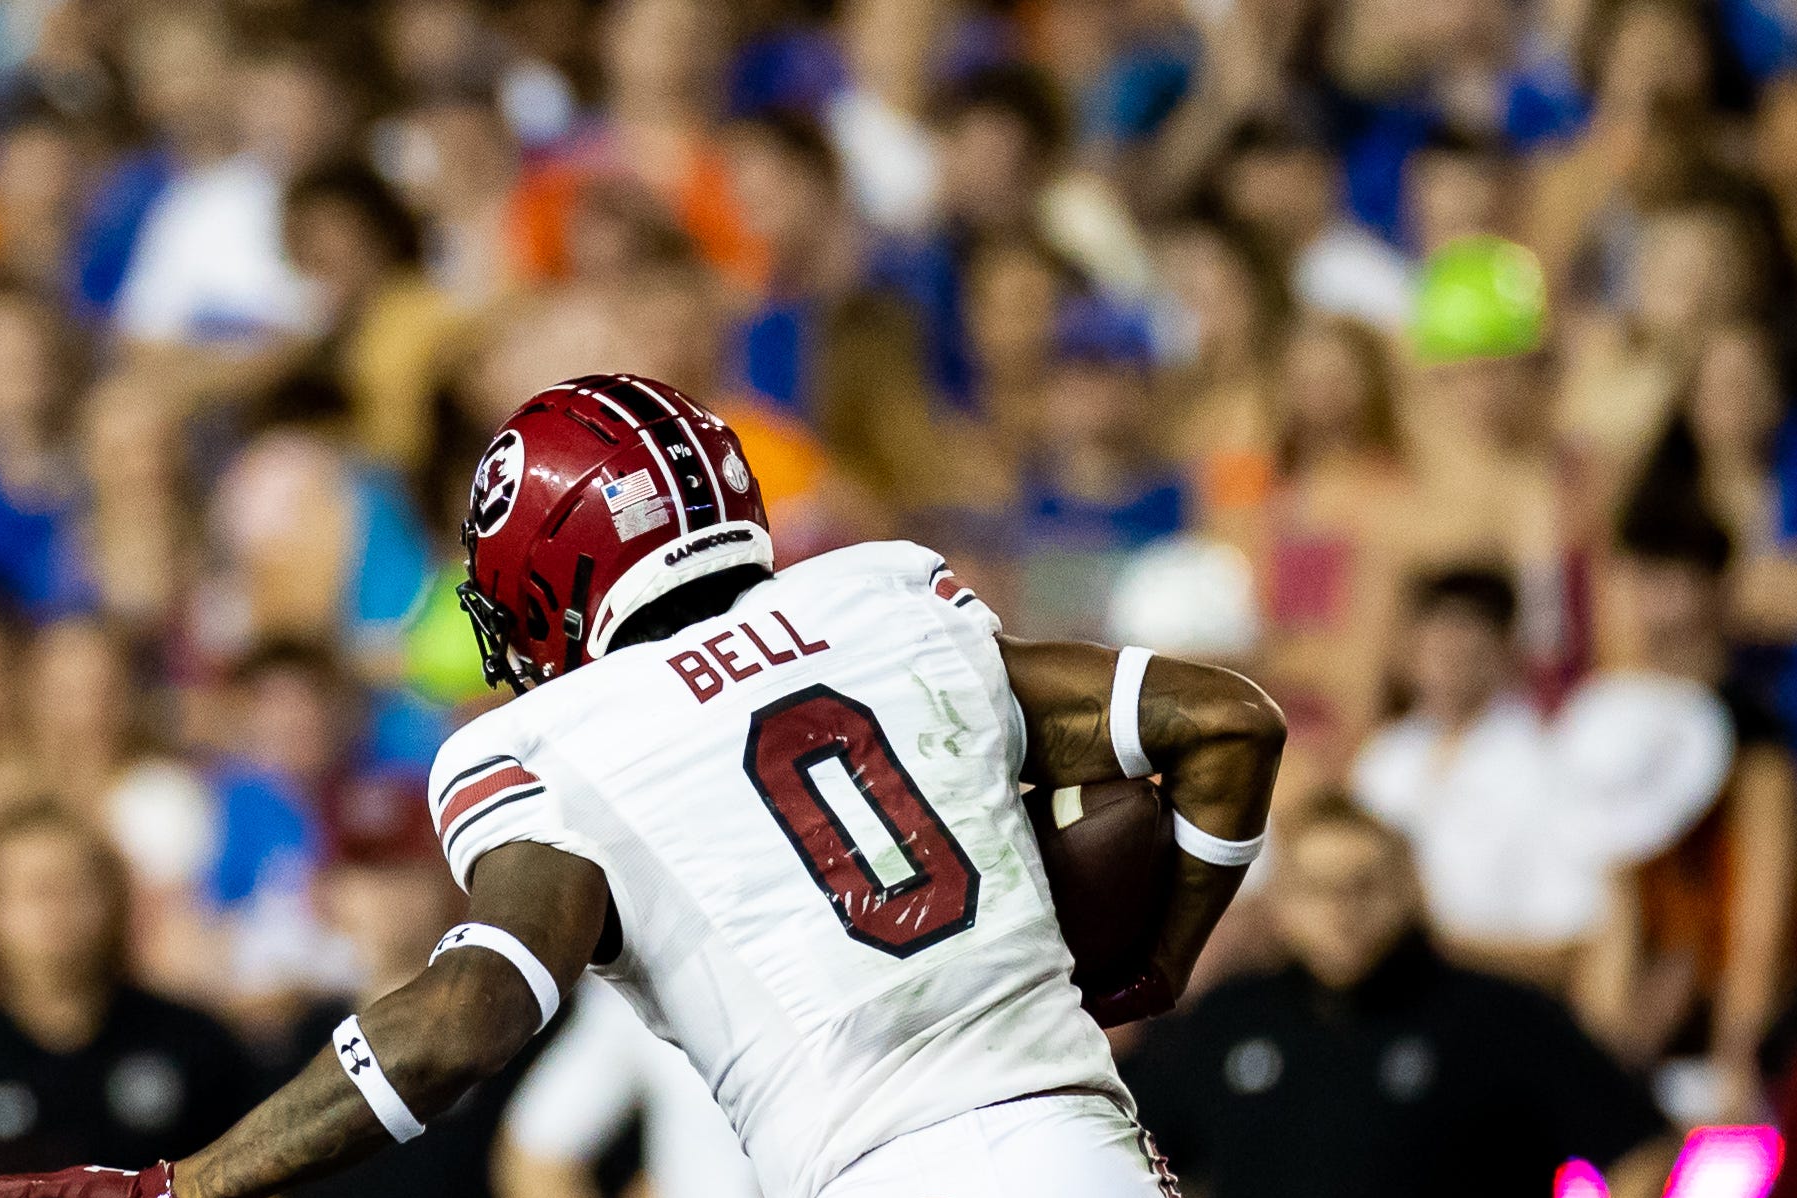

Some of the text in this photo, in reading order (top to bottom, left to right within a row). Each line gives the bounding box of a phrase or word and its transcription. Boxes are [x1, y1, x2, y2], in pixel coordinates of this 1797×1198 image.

[666, 443, 693, 461] 1%
[666, 610, 831, 705] BELL
[743, 683, 982, 960] 0
